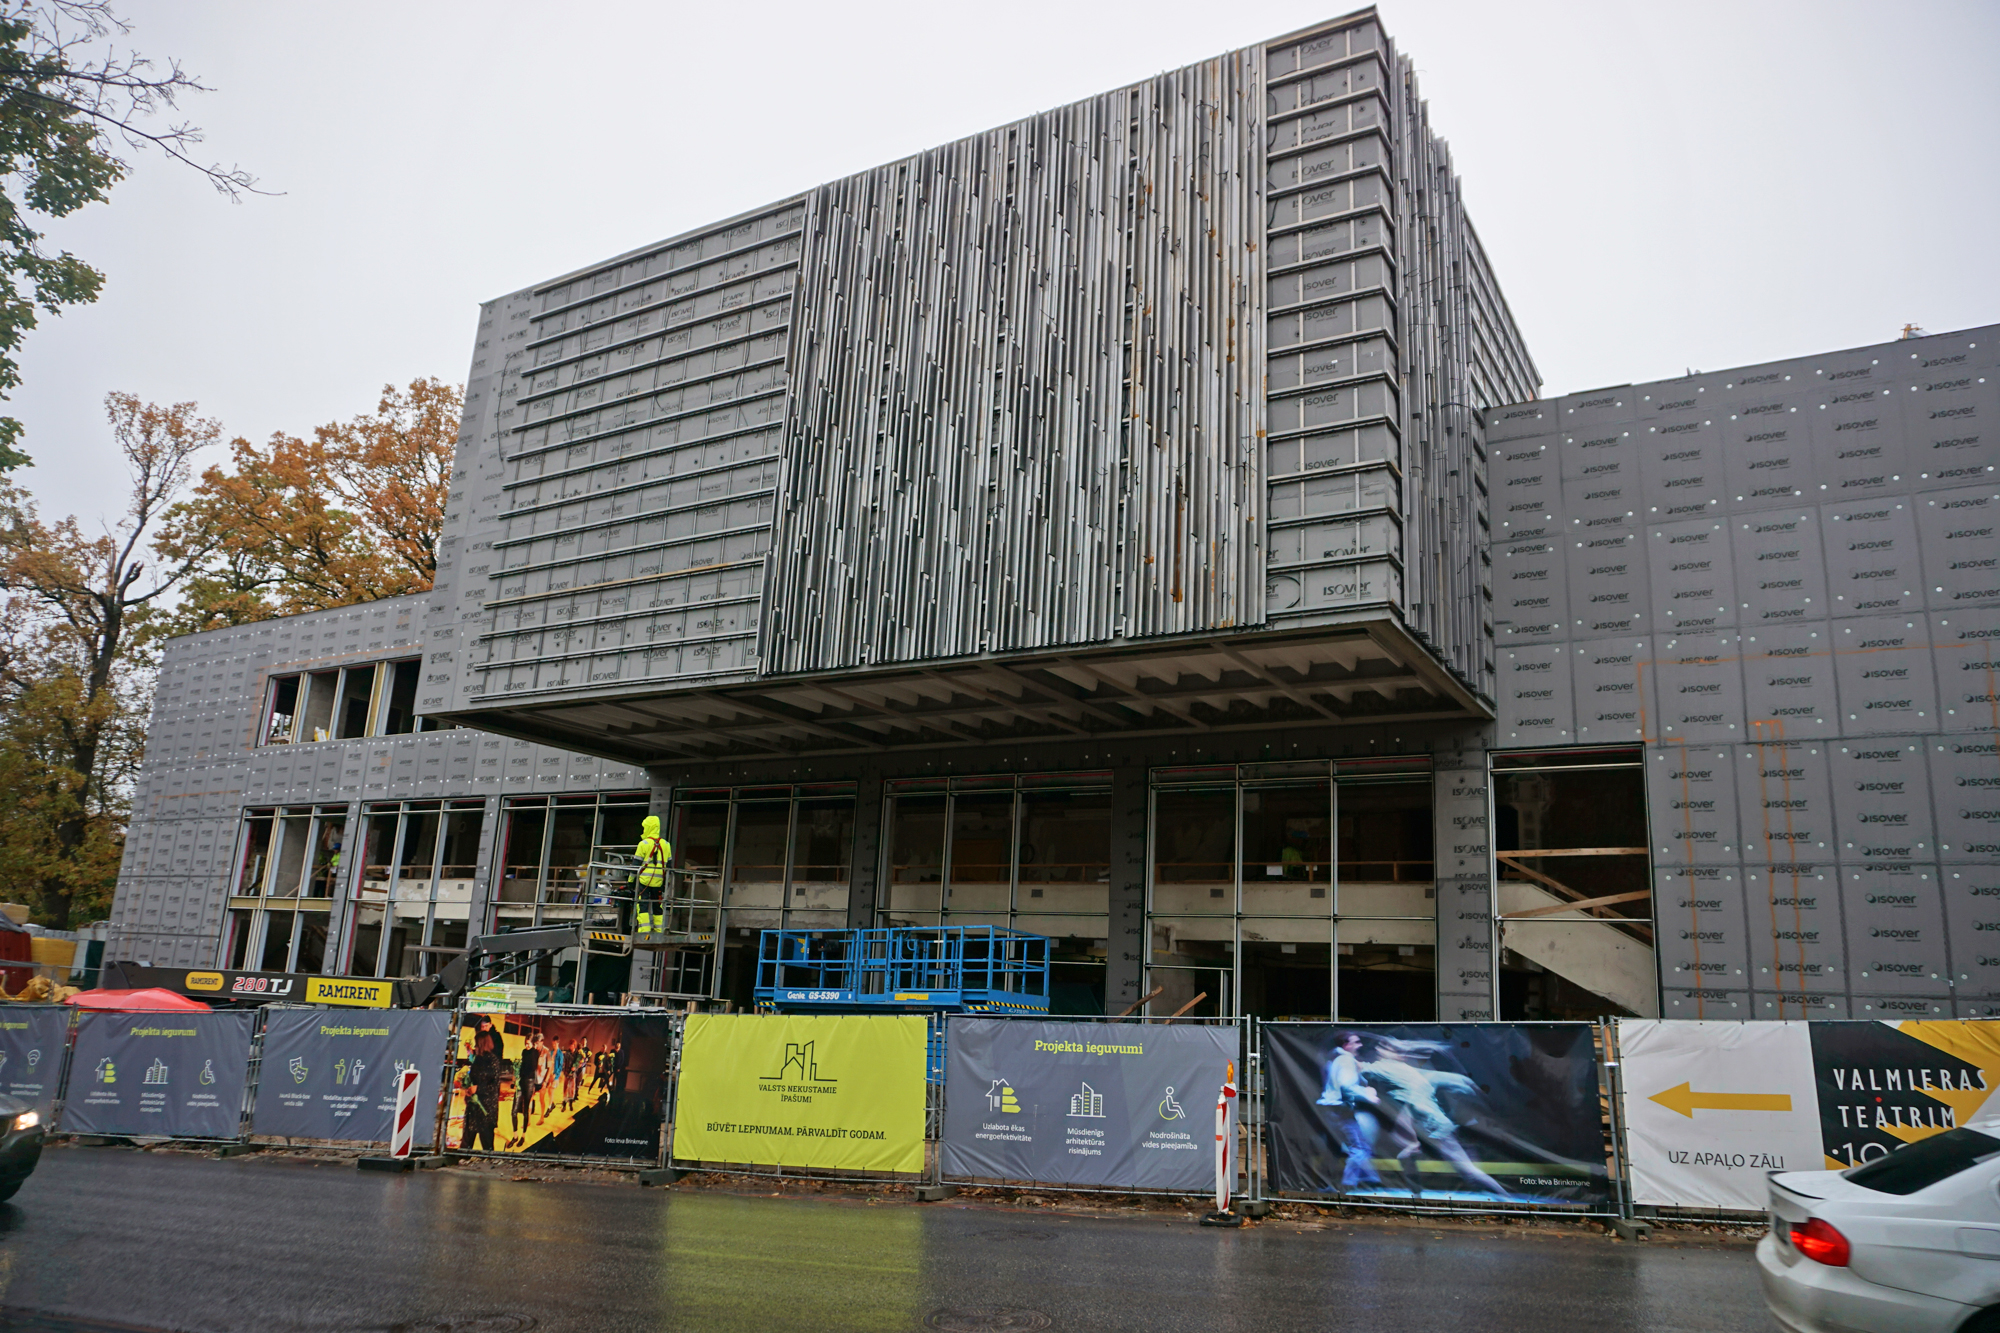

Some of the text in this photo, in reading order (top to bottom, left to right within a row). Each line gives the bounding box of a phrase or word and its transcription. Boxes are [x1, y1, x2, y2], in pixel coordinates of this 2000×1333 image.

[1669, 449, 1702, 460] isover
[1845, 446, 1883, 458] isover
[1755, 457, 1791, 468] isover
[1944, 465, 1984, 477] isover
[1671, 476, 1705, 487] isover
[1848, 475, 1886, 487] isover
[1591, 488, 1623, 499] isover
[1758, 485, 1794, 496] isover
[1950, 497, 1990, 508] isover
[1673, 503, 1707, 514] isover
[1853, 509, 1891, 520] isover
[1762, 521, 1798, 532] isover
[1676, 532, 1710, 543] isover
[1953, 527, 1994, 538] isover
[1594, 537, 1626, 547] isover
[1856, 539, 1894, 550] isover
[1765, 549, 1801, 560] isover
[1596, 564, 1628, 574] isover
[1678, 560, 1712, 570] isover
[1518, 569, 1549, 579] isover
[1860, 568, 1898, 579] isover
[1767, 578, 1804, 589] isover
[1598, 592, 1630, 602] isover
[1680, 588, 1715, 598] isover
[1519, 597, 1550, 606] isover
[1862, 598, 1901, 609] isover
[1770, 608, 1806, 618] isover
[1599, 620, 1632, 629] isover
[1867, 637, 1906, 648] isover
[1600, 654, 1634, 664] isover
[1522, 662, 1553, 670] isover
[1870, 668, 1909, 678] isover
[1776, 676, 1813, 685] isover
[1602, 682, 1635, 691] isover
[1687, 683, 1722, 693] isover
[1523, 689, 1554, 698] isover
[1873, 699, 1913, 709] isover
[1604, 711, 1637, 720] isover
[1779, 706, 1816, 715] isover
[1524, 717, 1556, 726] isover
[1689, 713, 1724, 723] isover
[1862, 750, 1901, 759] isover
[1678, 770, 1713, 779] isover
[1768, 768, 1805, 777] isover
[1865, 782, 1905, 791] isover
[1680, 800, 1716, 808] isover
[1771, 799, 1808, 808] isover
[1868, 814, 1909, 822] isover
[1682, 831, 1718, 839] isover
[1773, 831, 1811, 840] isover
[1872, 847, 1912, 856] isover
[1687, 900, 1723, 908] isover
[1779, 897, 1817, 906] isover
[1876, 895, 1917, 903] isover
[1689, 931, 1725, 940] isover
[1781, 931, 1820, 940] isover
[1880, 929, 1921, 938] isover
[1691, 962, 1727, 971] isover
[1784, 963, 1823, 972] isover
[1883, 963, 1924, 973] isover
[190, 976, 218, 986] RAMIRENT
[232, 976, 293, 993] 280 TJ
[318, 984, 380, 1000] RAMIRENT
[787, 992, 840, 1000] Genie GS-5390
[1887, 1001, 1929, 1010] isover
[130, 1027, 197, 1038] Projekta ieguvumi
[320, 1026, 390, 1038] Projekta ieguvumi
[1034, 1040, 1144, 1056] Projekta ieguvumi
[1833, 1068, 1988, 1092] VALMIERAS
[758, 1084, 837, 1094] VALSTS NEKUSTAMIE
[780, 1094, 812, 1103] ĪPAŠUMI
[1838, 1106, 1957, 1129] TEATRIM
[706, 1122, 887, 1140] BŪVĒT LEPNUMAM. PĀRVALDĪT GODAM.
[982, 1122, 1025, 1132] Uzlabota ēkas
[976, 1132, 1032, 1142] energoefektivitāte
[1067, 1128, 1104, 1138] Mūsdienīgs
[1150, 1131, 1190, 1140] Nodrošināta
[1066, 1138, 1106, 1146] arhitektūras
[1142, 1140, 1198, 1150] vides pieejamība
[1068, 1148, 1102, 1156] risinājums
[1668, 1150, 1785, 1170] UZ APAĻO ZĀLI
[1538, 1178, 1552, 1186] Ieva
[1554, 1178, 1590, 1186] Brinkmane
